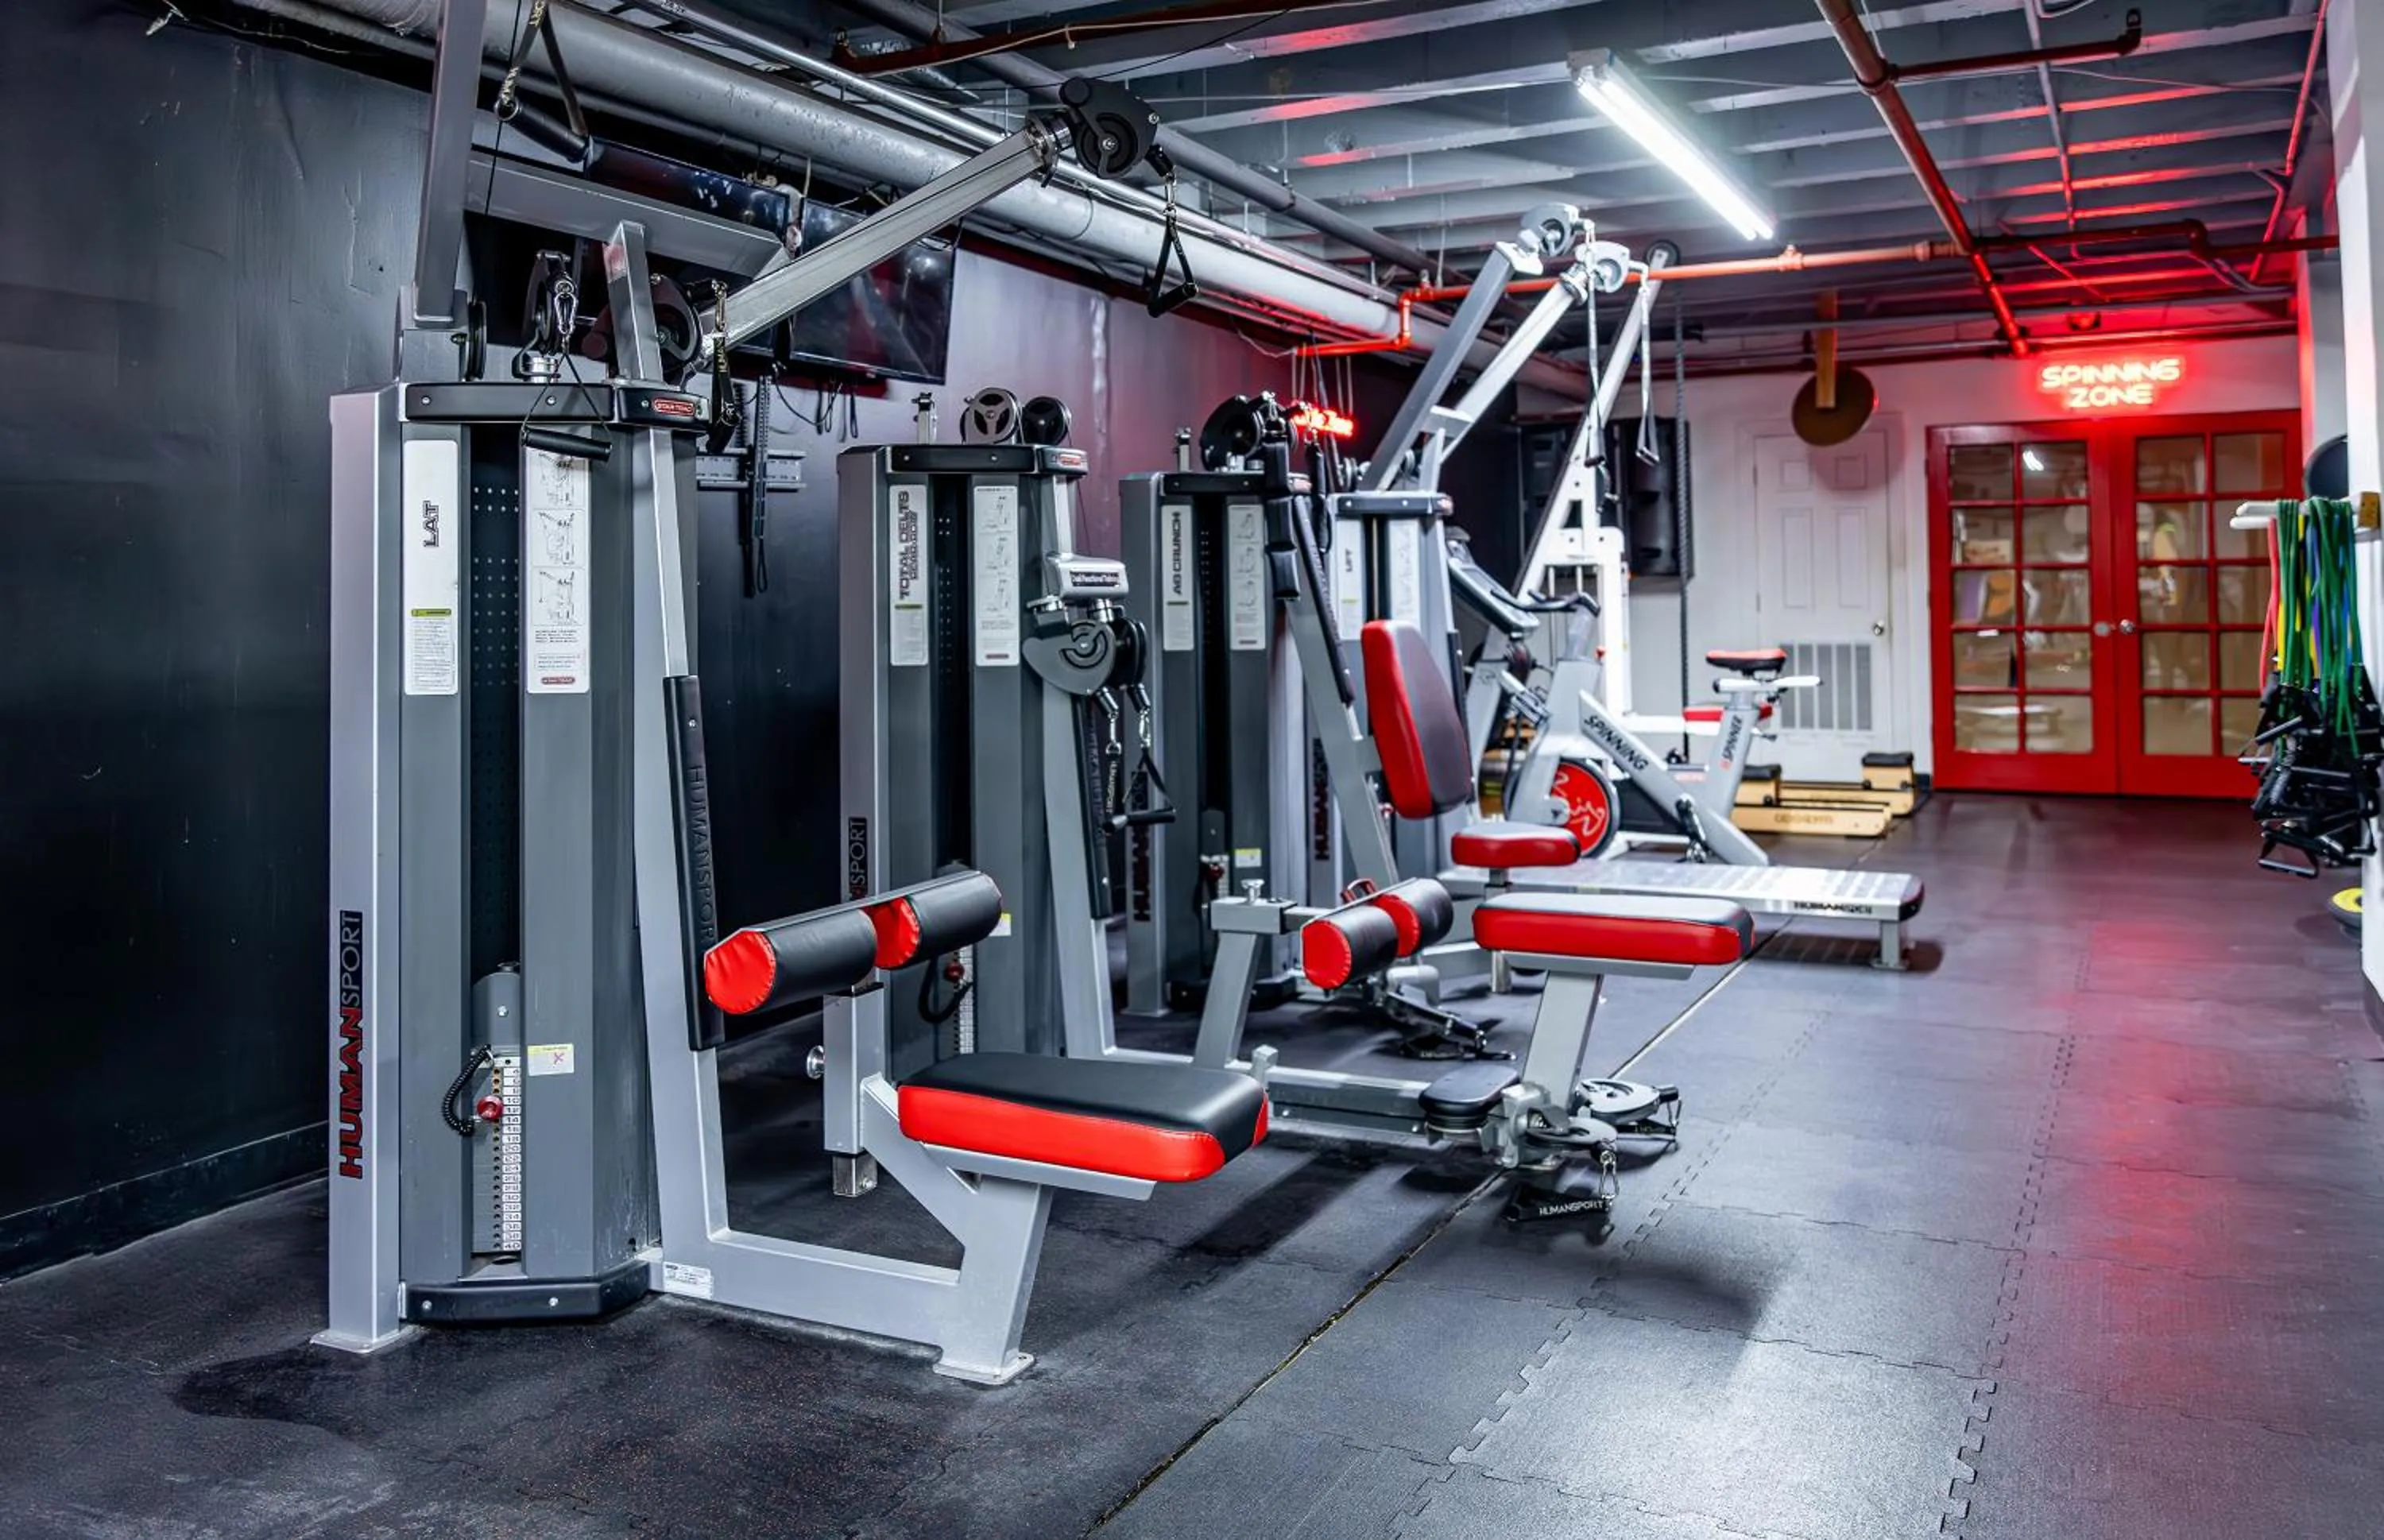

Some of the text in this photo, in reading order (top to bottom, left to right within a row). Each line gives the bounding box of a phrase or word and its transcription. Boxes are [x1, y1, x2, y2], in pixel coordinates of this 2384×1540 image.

[2041, 358, 2181, 389] SPINNING
[2069, 383, 2154, 408] ZONE
[423, 500, 439, 548] LAT
[898, 491, 910, 600] TOTAL DELTS
[1584, 715, 1649, 771] SPINNING
[687, 764, 714, 944] HUMANSPOR
[339, 911, 363, 1180] HUMANSPORT
